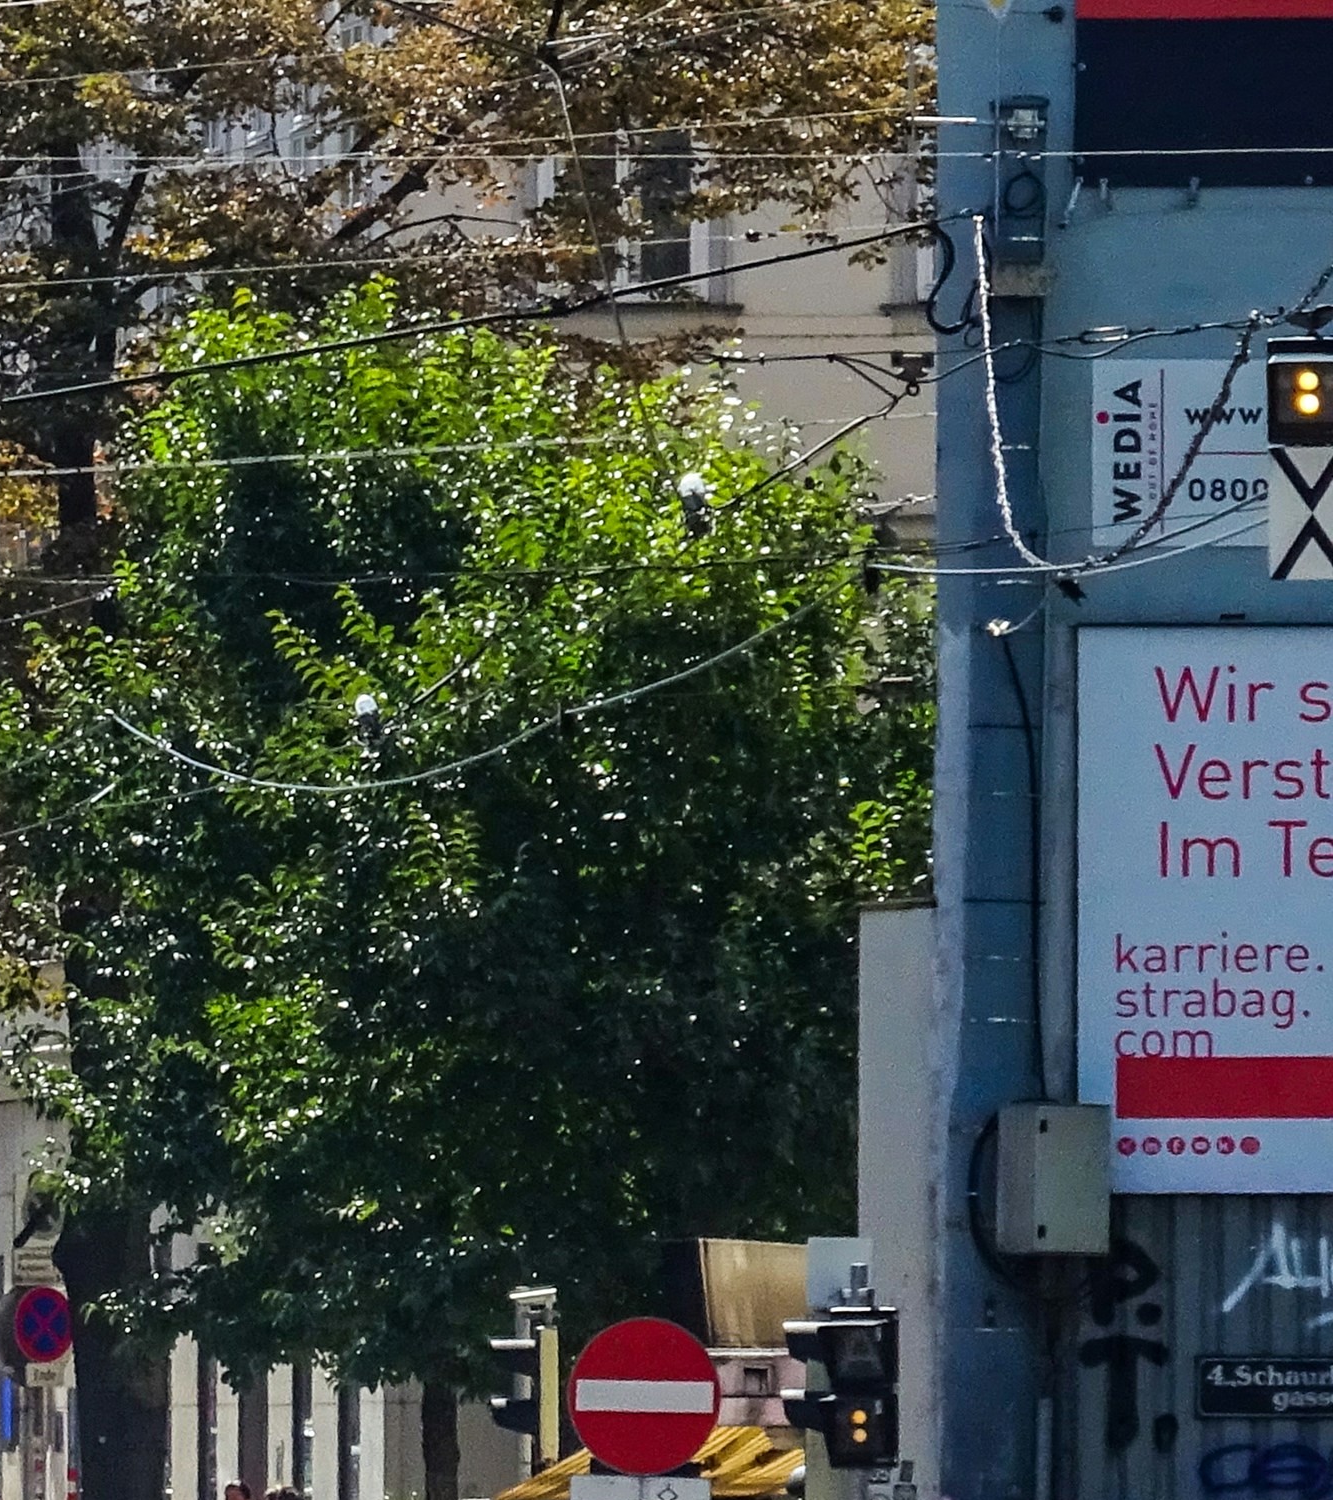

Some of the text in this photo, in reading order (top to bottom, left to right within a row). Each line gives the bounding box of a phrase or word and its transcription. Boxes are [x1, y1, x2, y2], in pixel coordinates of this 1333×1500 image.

[1112, 378, 1143, 523] WEDIA
[1154, 666, 1274, 723] Wir
[1154, 743, 1333, 800] Verst
[1159, 820, 1242, 878] Im
[1114, 932, 1325, 974] karriere.
[1114, 979, 1311, 1029] strabag.
[1114, 1028, 1214, 1058] com
[1235, 1364, 1333, 1387] Schaur
[1272, 1391, 1333, 1412] gass
